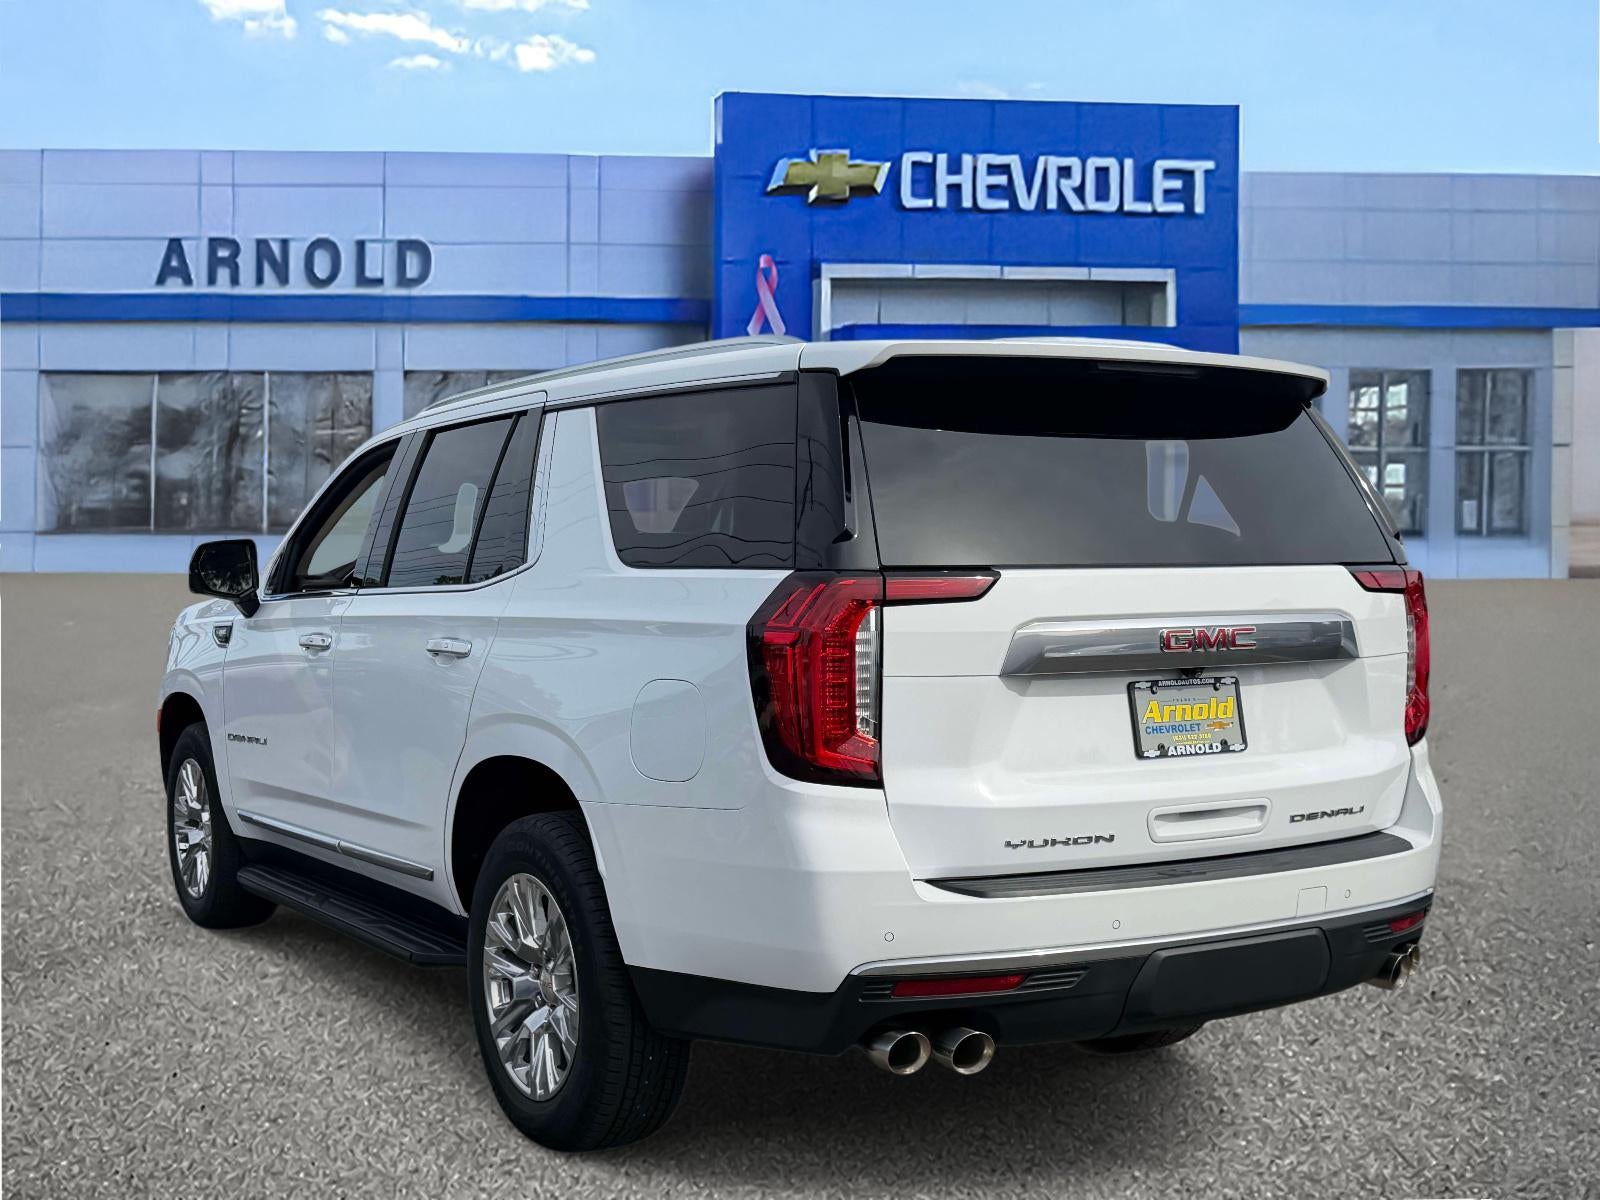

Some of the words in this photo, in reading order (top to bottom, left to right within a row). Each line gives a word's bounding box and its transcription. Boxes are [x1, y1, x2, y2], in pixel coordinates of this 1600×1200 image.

[901, 152, 1216, 214] CHEVROLET
[155, 236, 432, 288] ARNOLD
[1160, 626, 1257, 652] GMC
[1158, 678, 1215, 687] ARNOLDAUTOS.COM
[1141, 696, 1235, 724] Arnold
[1145, 723, 1202, 735] CHEVROLET
[1168, 742, 1221, 756] ARNOLD
[1289, 805, 1365, 824] DENALI
[1004, 834, 1115, 850] YUKON
